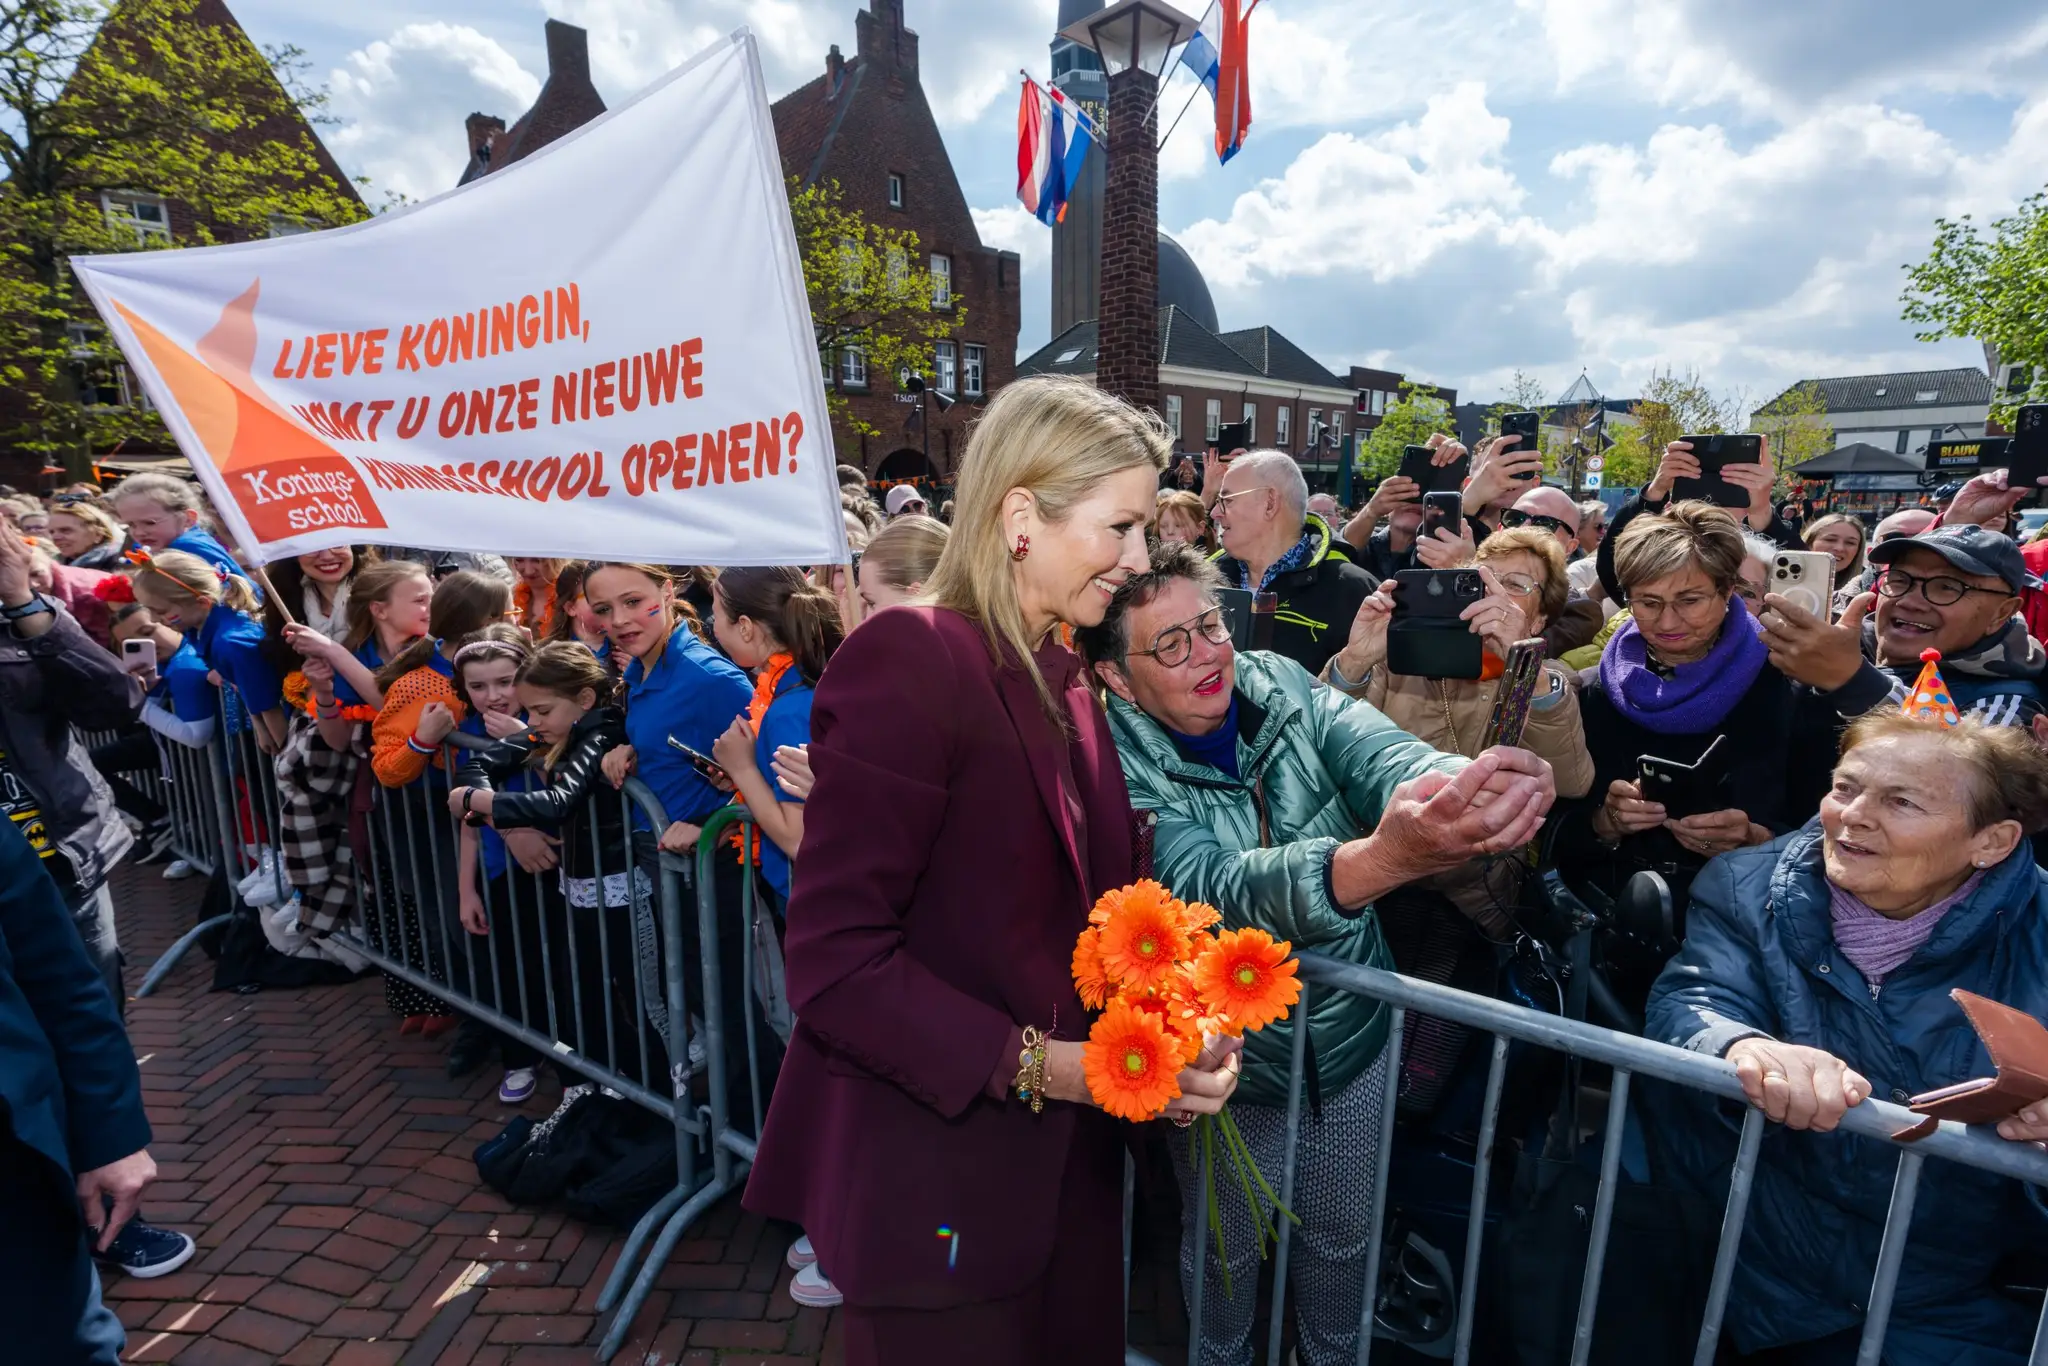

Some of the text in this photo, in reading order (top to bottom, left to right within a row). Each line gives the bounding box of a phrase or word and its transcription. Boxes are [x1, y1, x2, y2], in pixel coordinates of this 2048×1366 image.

[273, 282, 590, 379] LIEVE KONINGIN,
[397, 396, 430, 439] U
[438, 378, 540, 439] ONZE
[551, 337, 703, 425] NIEUWE
[621, 412, 804, 497] OPENEN?
[1940, 444, 1981, 457] BLAUW
[242, 465, 356, 505] Konings-
[288, 495, 368, 529] school
